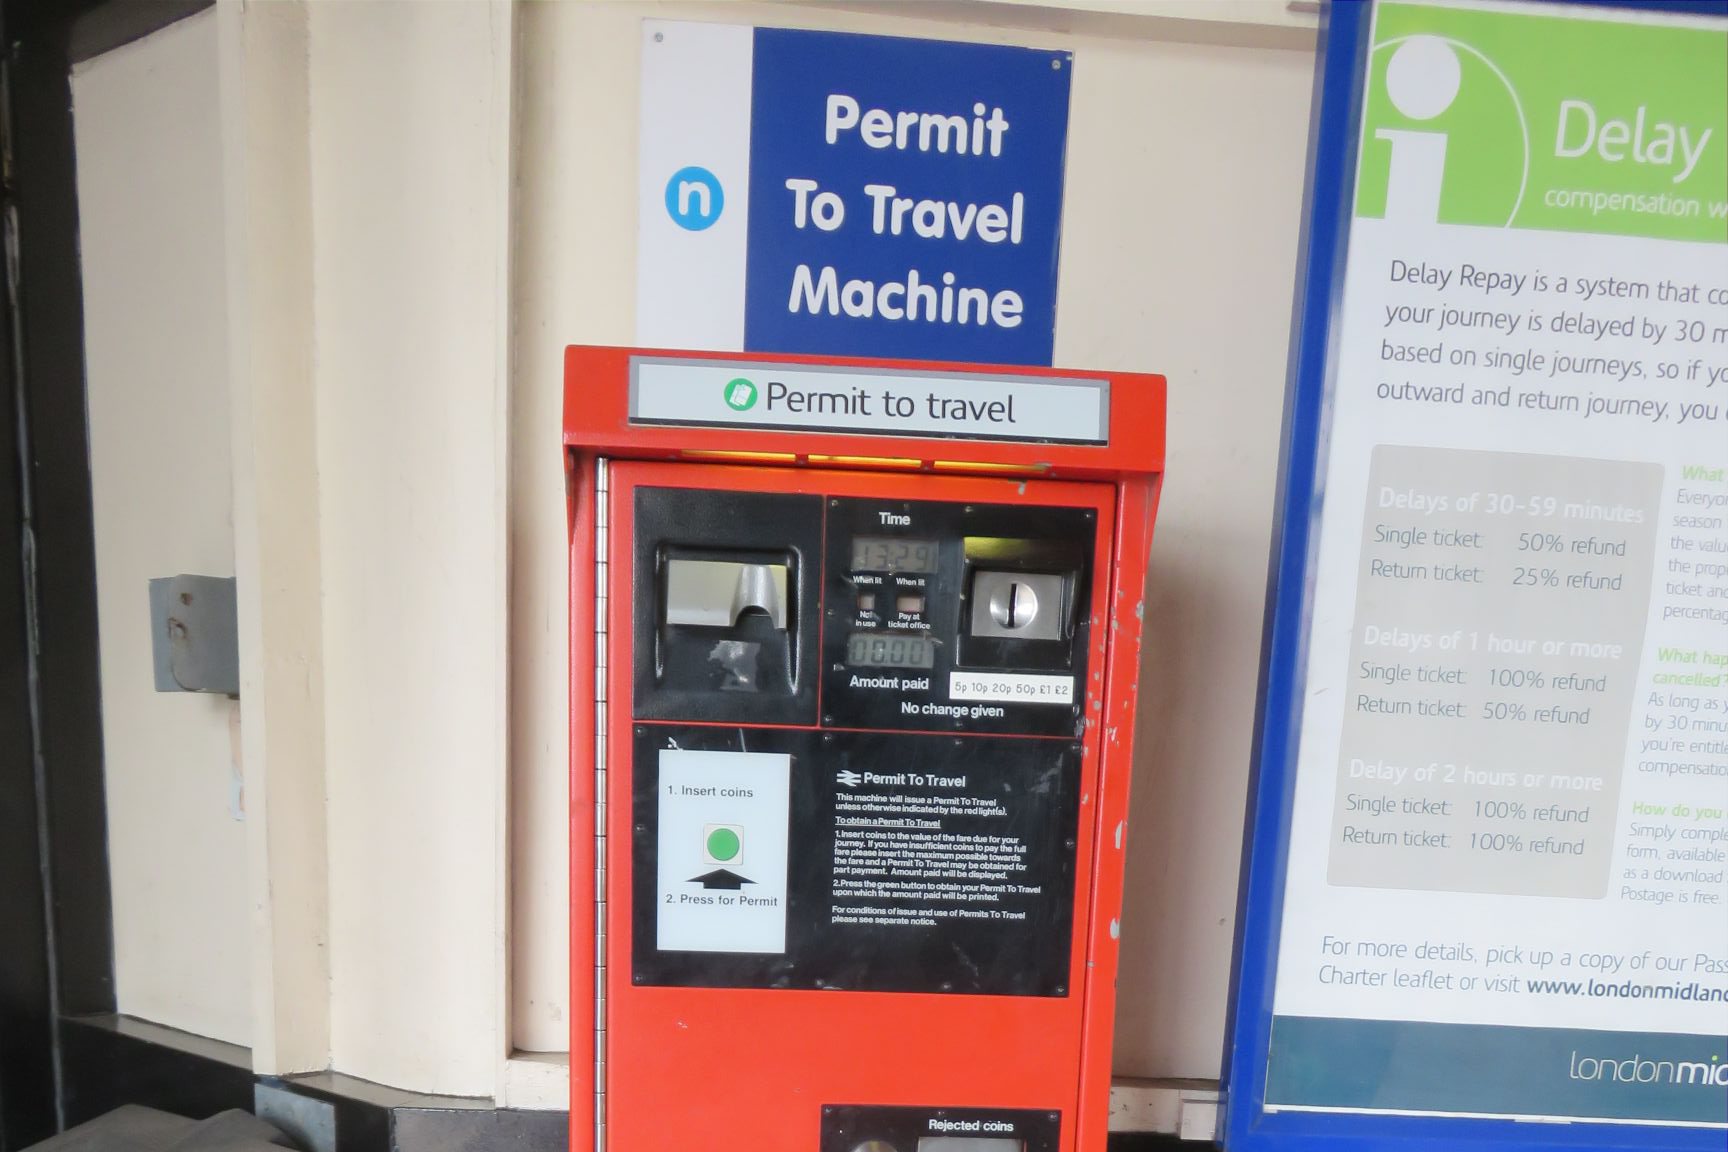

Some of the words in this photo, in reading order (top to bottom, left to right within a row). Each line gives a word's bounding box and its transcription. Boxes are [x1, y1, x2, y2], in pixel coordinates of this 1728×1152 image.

[824, 94, 1009, 157] Permit
[1555, 99, 1713, 184] Delay
[785, 178, 844, 231] To
[864, 184, 1024, 245] Travel
[1544, 189, 1700, 217] compensation
[1390, 259, 1453, 292] Delay
[1460, 264, 1527, 297] Repay
[1533, 269, 1548, 292] is
[1555, 276, 1568, 293] a
[1575, 277, 1650, 301] system
[1657, 280, 1700, 303] that
[788, 264, 1024, 328] Machine
[1384, 305, 1435, 328] your
[1437, 303, 1521, 336] journey
[1527, 309, 1543, 331] is
[1551, 310, 1635, 342] delayed
[1641, 317, 1667, 346] by
[1674, 319, 1705, 343] 30
[1381, 338, 1443, 364] based
[1449, 349, 1476, 366] on
[1483, 346, 1545, 376] single
[1549, 350, 1647, 383] journeys,
[1656, 361, 1679, 380] so
[1686, 359, 1703, 381] if
[766, 381, 871, 416] Permit
[882, 389, 915, 418] to
[926, 392, 1016, 423] travel
[1376, 381, 1465, 404] outward
[1471, 386, 1511, 407] and
[1518, 390, 1579, 411] return
[1584, 391, 1669, 423] journey,
[1677, 401, 1719, 424] you
[1682, 464, 1724, 482] What
[879, 511, 911, 526] Time
[1378, 487, 1449, 516] Delays
[1455, 491, 1480, 513] of
[1563, 500, 1645, 525] minutes
[1672, 514, 1722, 529] season
[1374, 524, 1427, 549] Single
[1518, 532, 1564, 553] 50%
[1571, 536, 1627, 557] refund
[853, 575, 874, 585] When
[875, 576, 883, 585] lit
[896, 577, 917, 586] When
[917, 578, 925, 587] lit
[1370, 558, 1427, 580] Return
[1512, 567, 1560, 588] 25%
[1566, 570, 1623, 591] refund
[855, 619, 863, 627] in
[863, 620, 877, 628] use
[888, 620, 909, 629] ticket
[909, 621, 931, 630] office
[898, 612, 912, 622] Pay
[1364, 625, 1433, 654] Delays
[1438, 630, 1464, 651] of
[1470, 631, 1478, 651] 1
[1487, 632, 1537, 655] hour
[1542, 639, 1566, 656] or
[1569, 641, 1623, 660] more
[849, 674, 899, 689] Amount
[901, 678, 929, 692] paid
[954, 680, 968, 694] 5p
[971, 681, 988, 694] 10p
[992, 683, 1012, 696] 20p
[1016, 684, 1036, 697] 50p
[1039, 685, 1051, 695] £1
[1055, 685, 1069, 696] £2
[1359, 661, 1411, 685] Single
[1489, 668, 1545, 689] 100%
[1551, 672, 1607, 693] refund
[901, 701, 920, 714] No
[921, 702, 969, 718] change
[970, 705, 1004, 719] given
[1356, 694, 1412, 715] Return
[1482, 701, 1527, 722] 50%
[1533, 705, 1591, 725] refund
[863, 771, 906, 786] Permit
[907, 773, 924, 787] To
[925, 774, 966, 788] Travel
[1349, 757, 1408, 785] Delay
[1413, 762, 1439, 783] of
[1443, 764, 1457, 783] 2
[1463, 765, 1517, 788] hours
[1523, 771, 1545, 789] or
[1550, 773, 1604, 792] more
[668, 785, 678, 796] 1.
[681, 785, 716, 797] Insert
[720, 786, 754, 798] coins
[836, 792, 853, 801] This
[854, 794, 888, 803] machine
[888, 795, 903, 803] will
[904, 796, 926, 804] issue
[933, 796, 960, 806] Permit
[960, 797, 971, 806] To
[971, 798, 997, 807] Travel
[835, 803, 861, 811] unless
[861, 803, 901, 812] otherwise
[902, 804, 939, 814] indicated
[939, 806, 949, 815] by
[949, 806, 963, 815] the
[964, 807, 978, 815] red
[978, 807, 1008, 817] light(s).
[1345, 793, 1397, 817] Single
[1474, 800, 1527, 821] 100%
[1533, 804, 1590, 824] refund
[1342, 825, 1398, 845] Return
[1470, 832, 1523, 852] 100%
[1529, 836, 1585, 856] refund
[665, 894, 676, 904] 2.
[680, 894, 714, 905] Press
[718, 895, 735, 905] for
[739, 896, 778, 907] Permit
[1620, 885, 1674, 906] Postage
[1679, 889, 1688, 903] is
[1693, 889, 1722, 905] free.
[1322, 935, 1351, 956] For
[1357, 942, 1408, 958] more
[1414, 941, 1478, 964] details,
[1486, 945, 1523, 967] pick
[1529, 950, 1554, 970] up
[1560, 952, 1572, 967] a
[1579, 952, 1625, 974] copy
[1630, 950, 1651, 970] of
[1655, 955, 1688, 971] our
[1318, 964, 1388, 987] Charter
[1393, 967, 1454, 990] leaflet
[1459, 975, 1479, 991] or
[1484, 973, 1521, 993] visit
[928, 1118, 980, 1132] Rejected
[983, 1120, 1014, 1132] coins
